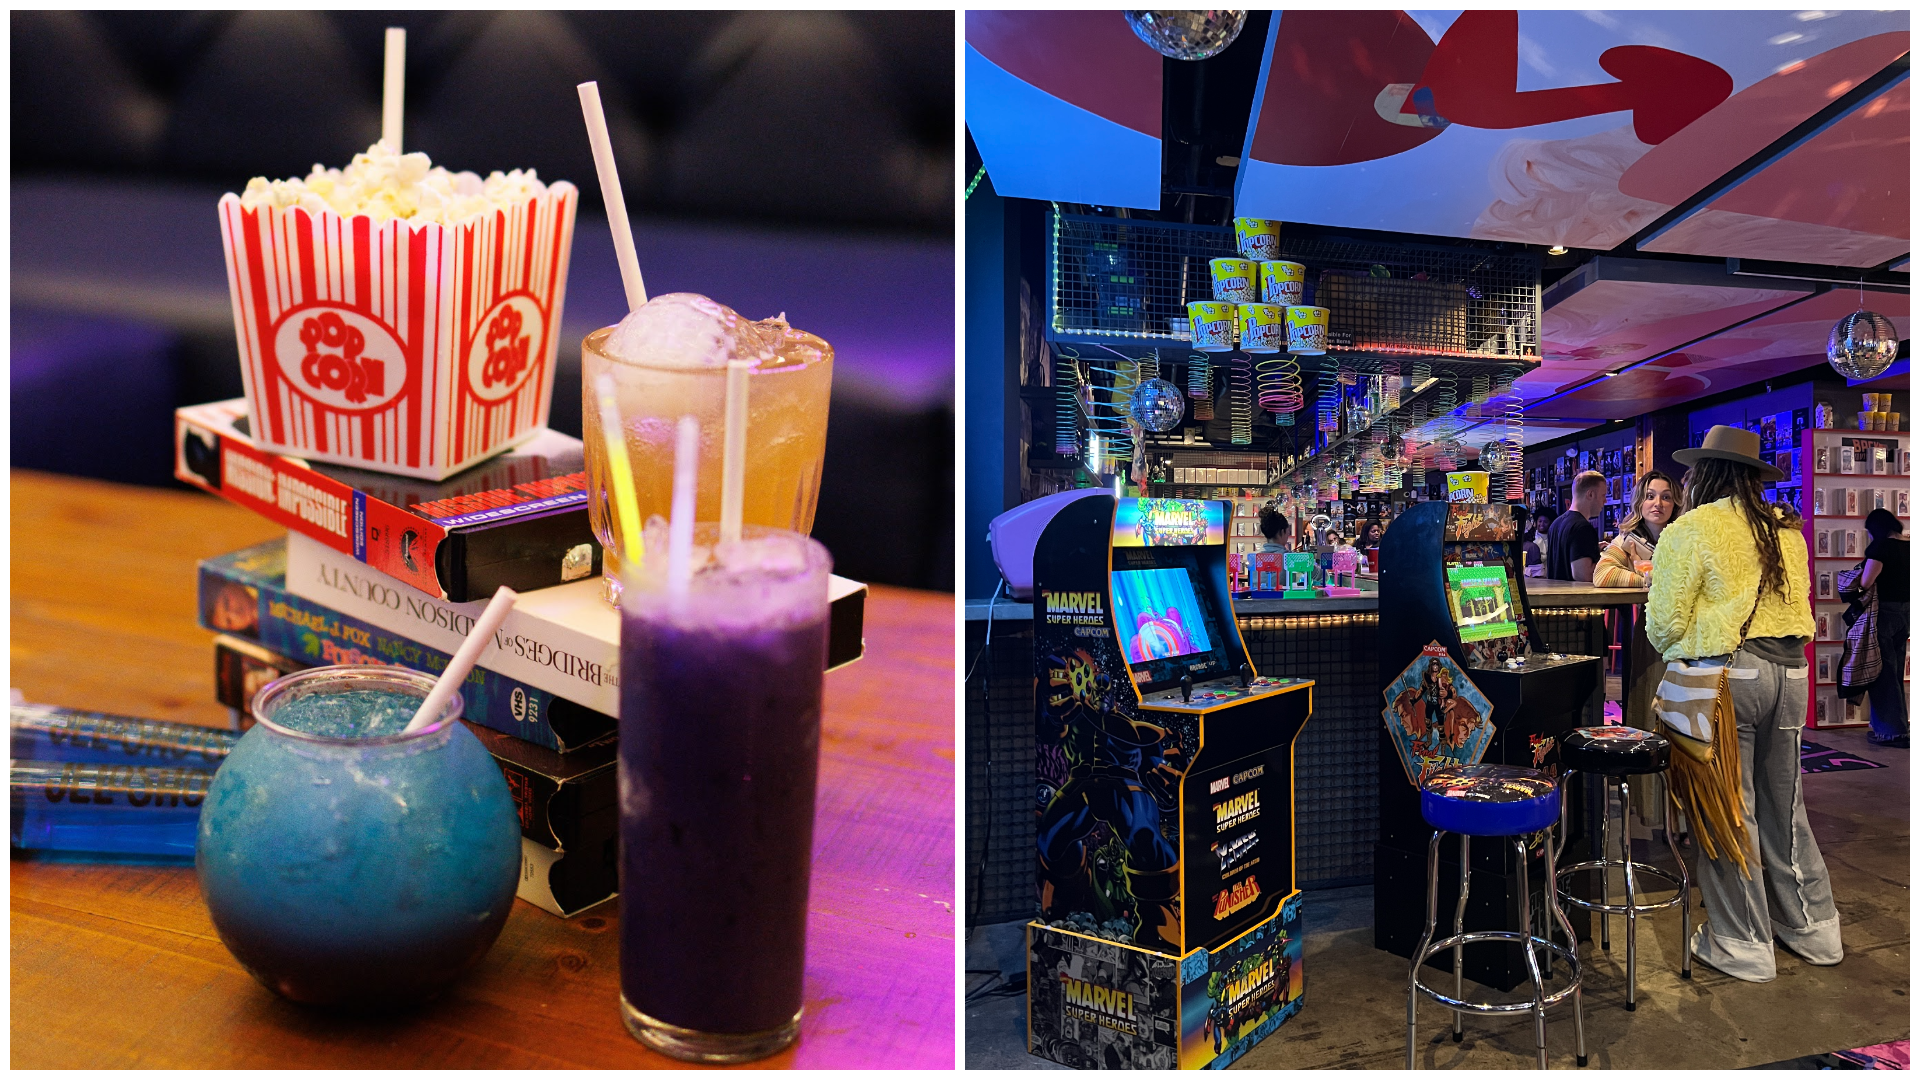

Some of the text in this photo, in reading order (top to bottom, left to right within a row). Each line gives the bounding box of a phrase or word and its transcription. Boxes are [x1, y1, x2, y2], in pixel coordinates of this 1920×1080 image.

[299, 311, 365, 359] POP
[485, 303, 523, 354] POP
[301, 352, 385, 404] CORN
[482, 335, 530, 388] CORN
[277, 471, 348, 538] IMPOSSIBLE
[443, 494, 588, 525] WIDESCREEN
[1154, 511, 1194, 526] MARVEL
[316, 563, 400, 612] COUNTY
[1044, 590, 1104, 614] MARVEL
[269, 600, 325, 633] MICHAEL
[341, 624, 373, 649] FOX
[1046, 614, 1104, 626] SUPER HEROES
[1073, 626, 1110, 639] CAPCOM
[503, 636, 514, 648] OF
[514, 634, 603, 687] BRIDGES
[514, 690, 524, 717] VHS
[528, 696, 539, 723] 9231
[1411, 740, 1440, 759] Final
[1210, 764, 1265, 795] MARVEL CAPCOM
[1214, 789, 1260, 824] MARVEL
[1216, 808, 1260, 834] SUPER HEROES
[1213, 875, 1261, 920] PUNISHER
[1064, 977, 1137, 1022] MARVEL
[1227, 958, 1275, 1006] MARVEL
[1228, 980, 1275, 1018] SUPER HEROES
[1065, 1005, 1097, 1024] SUPER
[1098, 1014, 1138, 1036] HEROES
